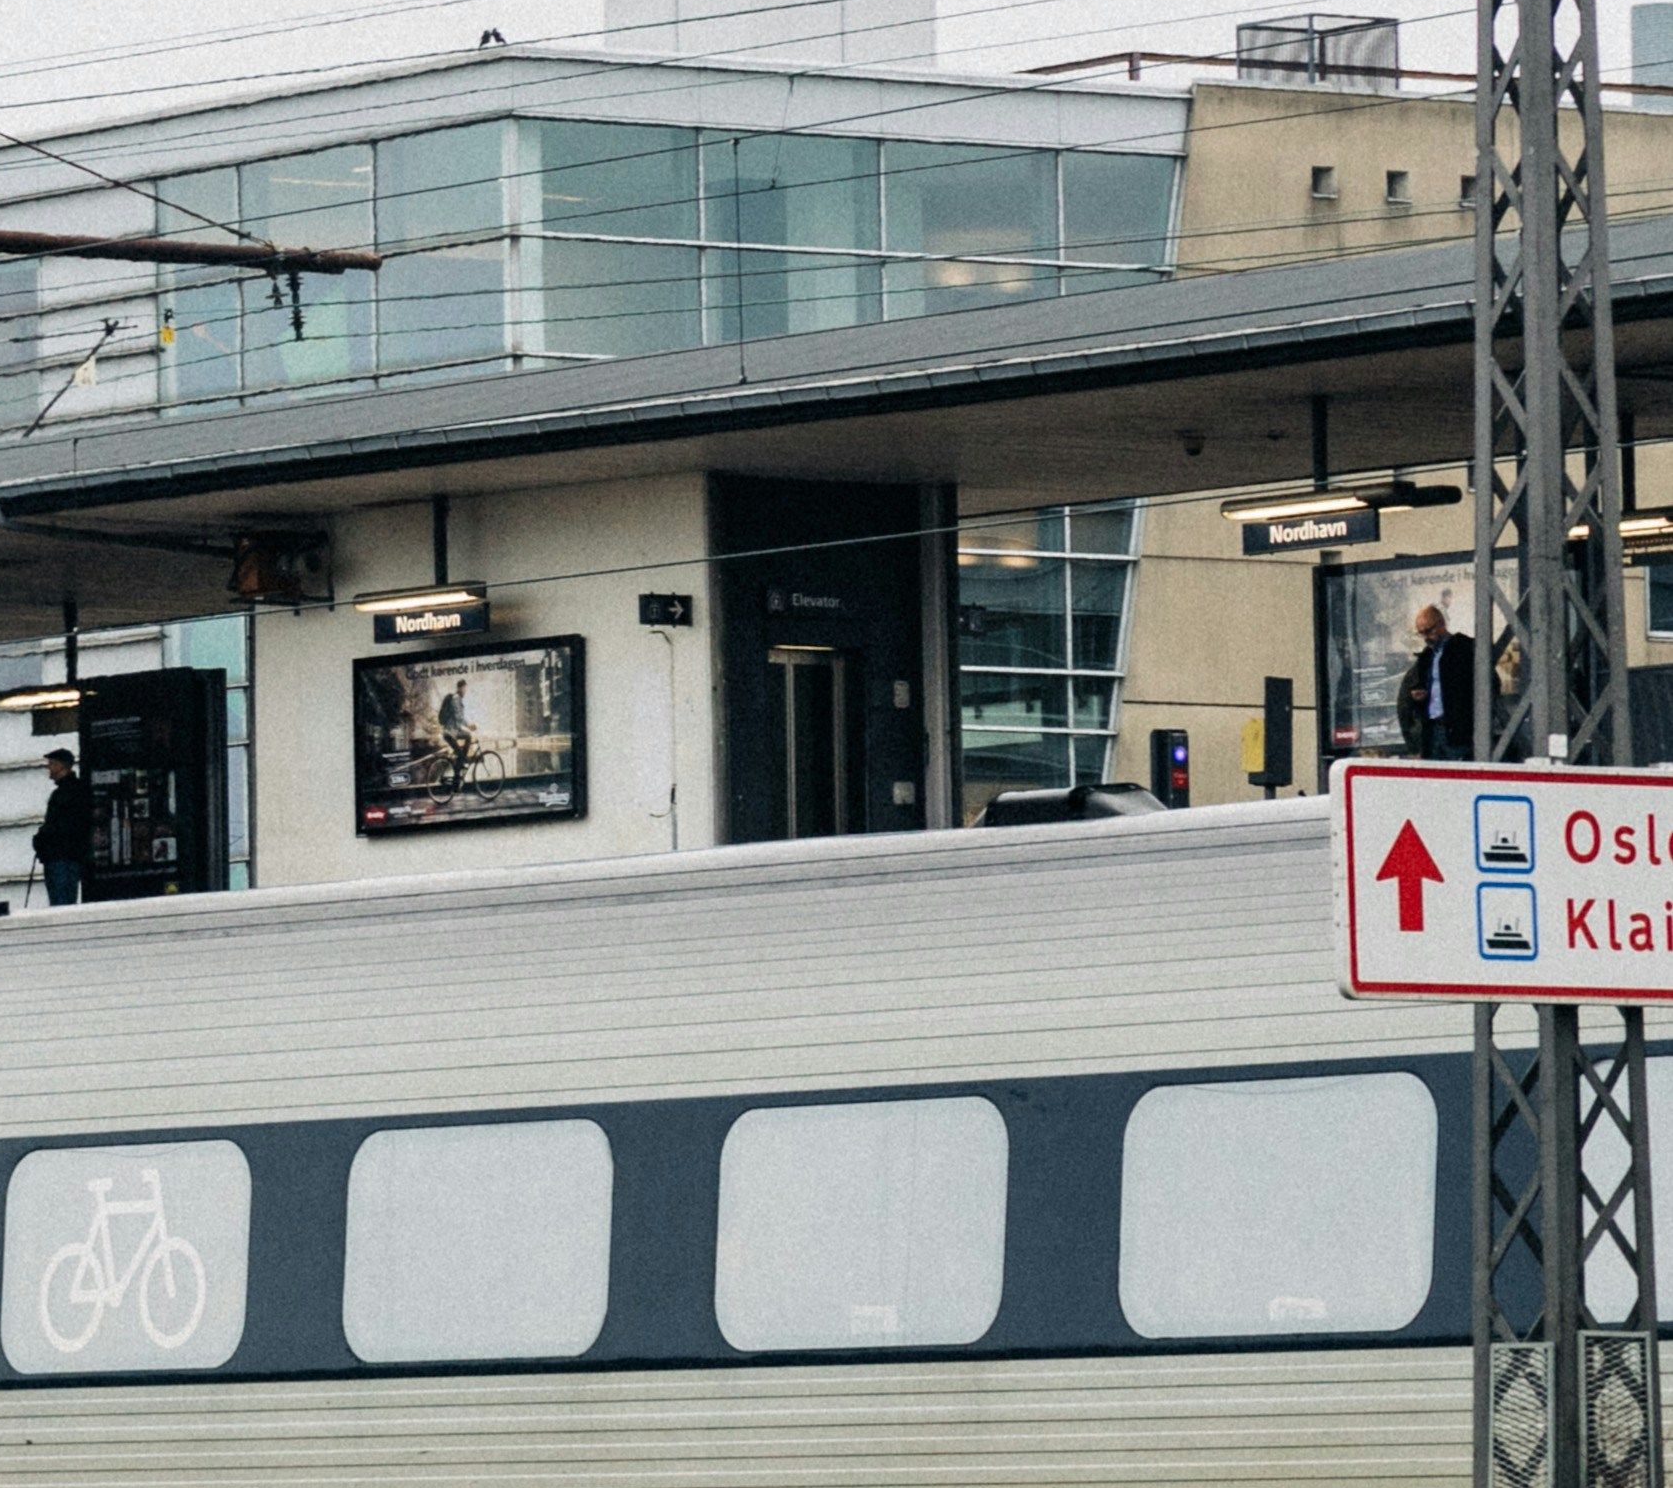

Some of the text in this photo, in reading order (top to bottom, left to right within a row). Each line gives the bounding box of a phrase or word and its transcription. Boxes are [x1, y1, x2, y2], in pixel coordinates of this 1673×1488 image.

[1269, 520, 1348, 544] Nordhavn
[792, 593, 841, 609] Elevator
[395, 612, 462, 634] Nordhavn
[1566, 898, 1673, 951] Klai
